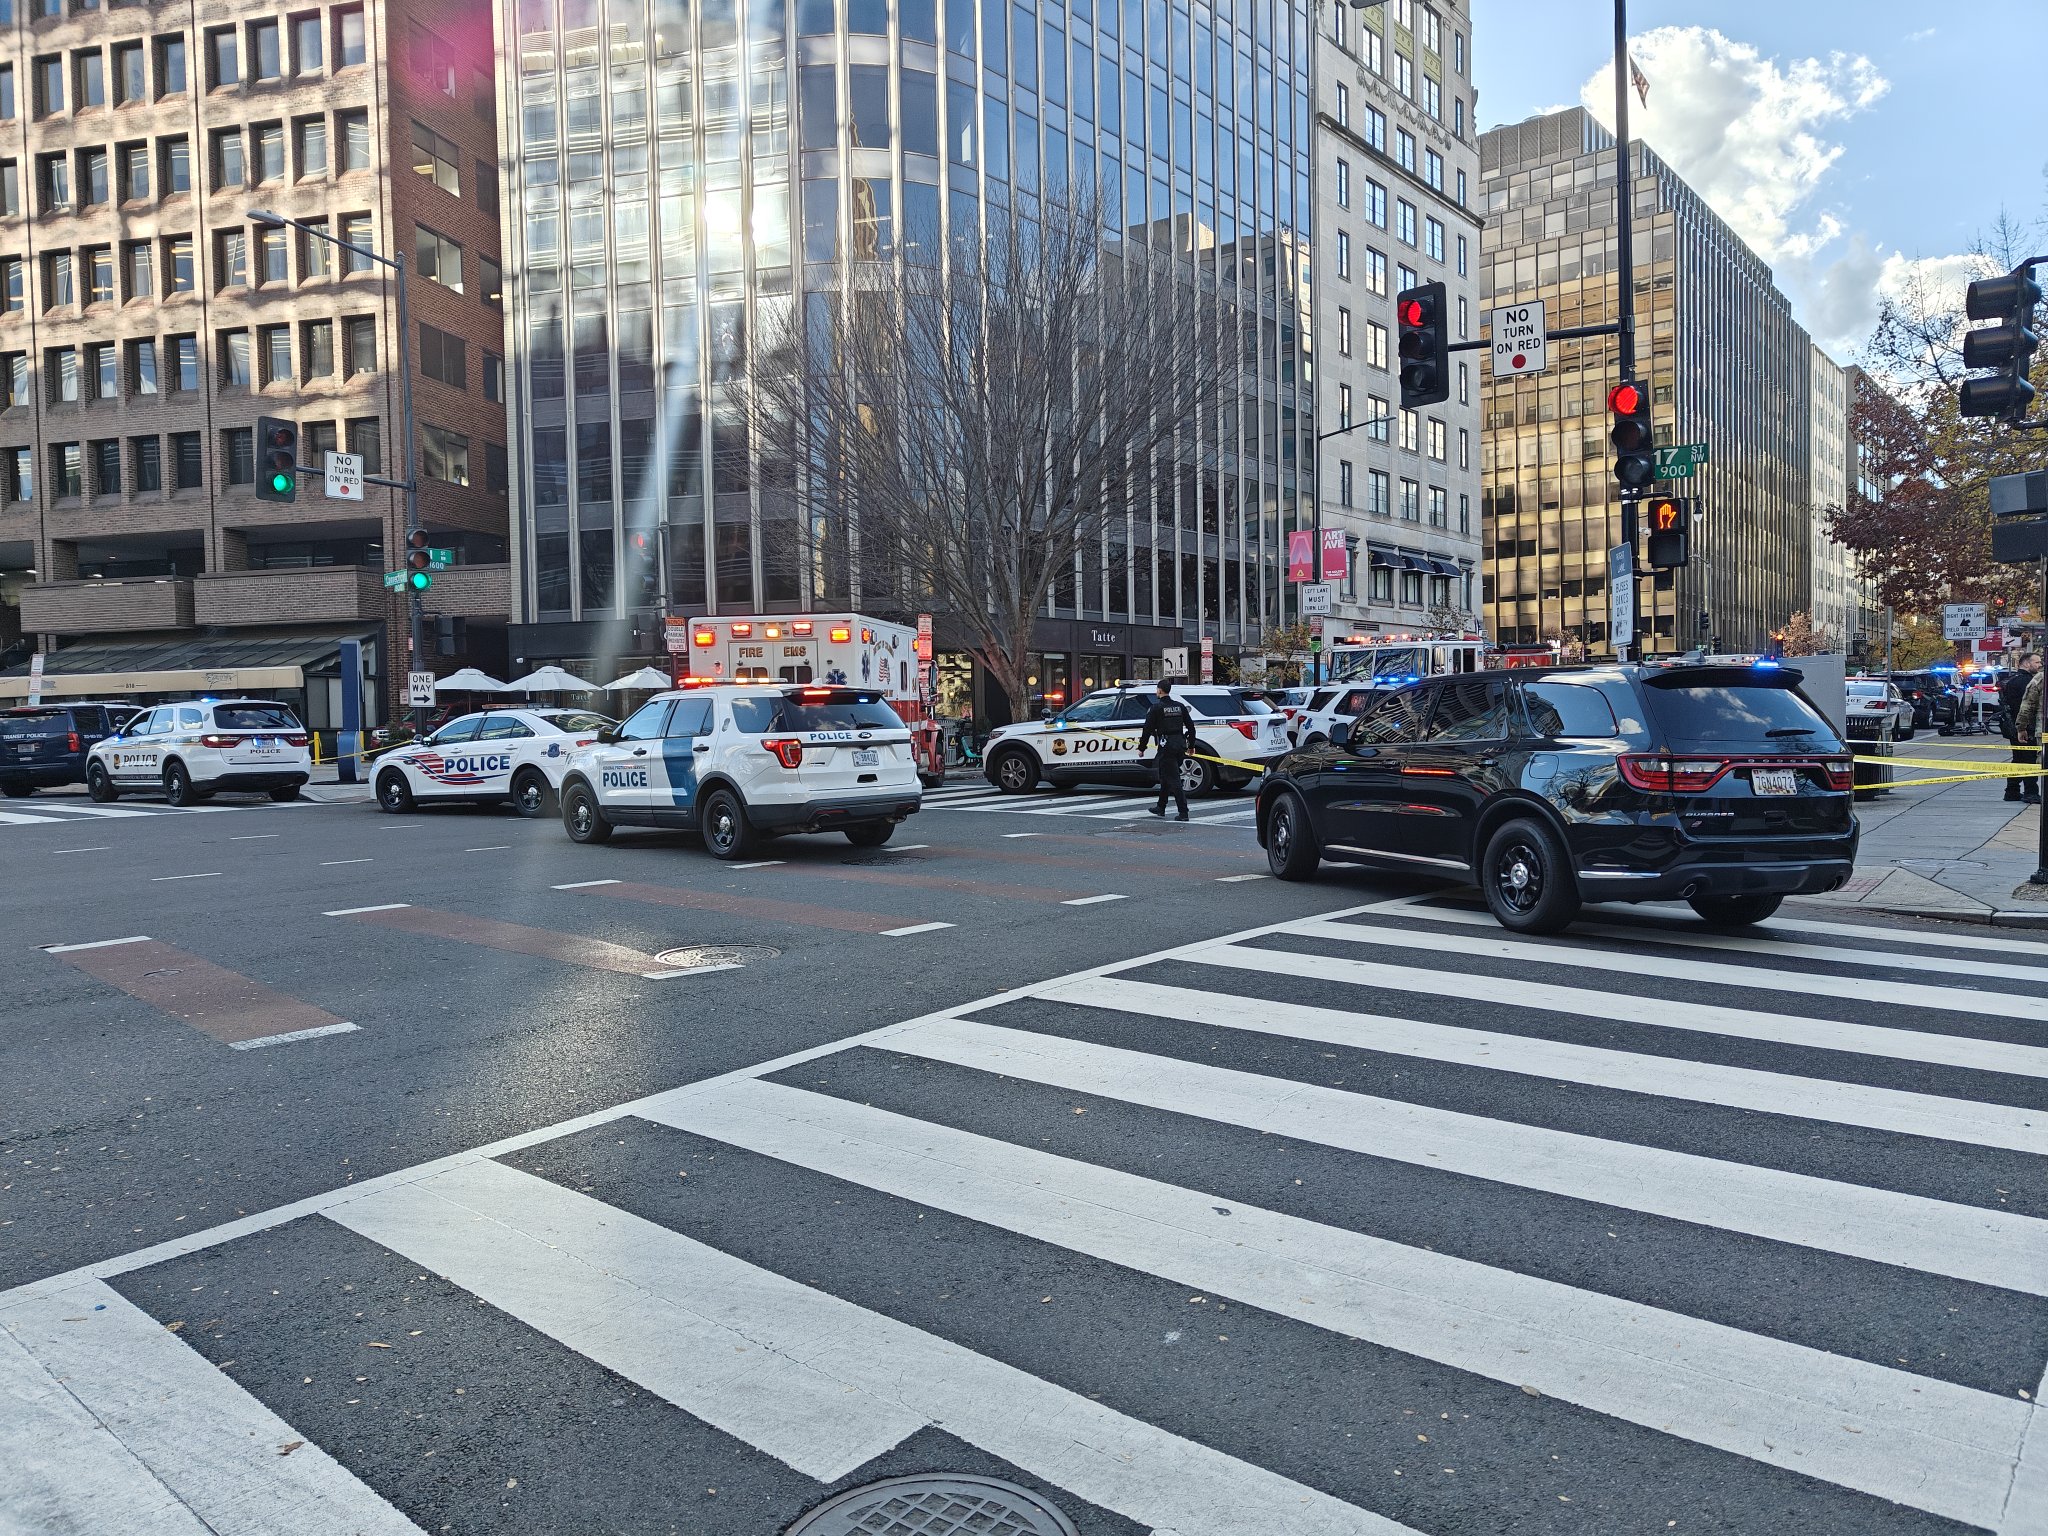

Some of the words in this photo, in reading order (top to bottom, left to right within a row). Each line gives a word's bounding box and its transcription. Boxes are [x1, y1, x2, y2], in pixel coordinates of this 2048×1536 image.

[1506, 309, 1528, 324] NO
[1503, 324, 1533, 338] TURN
[1497, 342, 1512, 354] ON
[1518, 338, 1540, 351] RED
[1691, 445, 1704, 454] ST
[336, 456, 352, 465] NO
[1653, 448, 1678, 465] 17
[1691, 454, 1704, 462] NW
[334, 467, 354, 475] TURN
[1660, 465, 1686, 477] 900
[1324, 530, 1344, 540] ART
[1324, 540, 1344, 549] AVE
[1091, 630, 1116, 643] Tatte
[739, 647, 764, 658] FIRE
[783, 646, 806, 657] EMS
[412, 684, 431, 692] WAY
[1072, 737, 1146, 753] POLIC
[122, 755, 157, 767] POLICE
[444, 756, 510, 773] POLICE
[603, 772, 647, 787] POLICE
